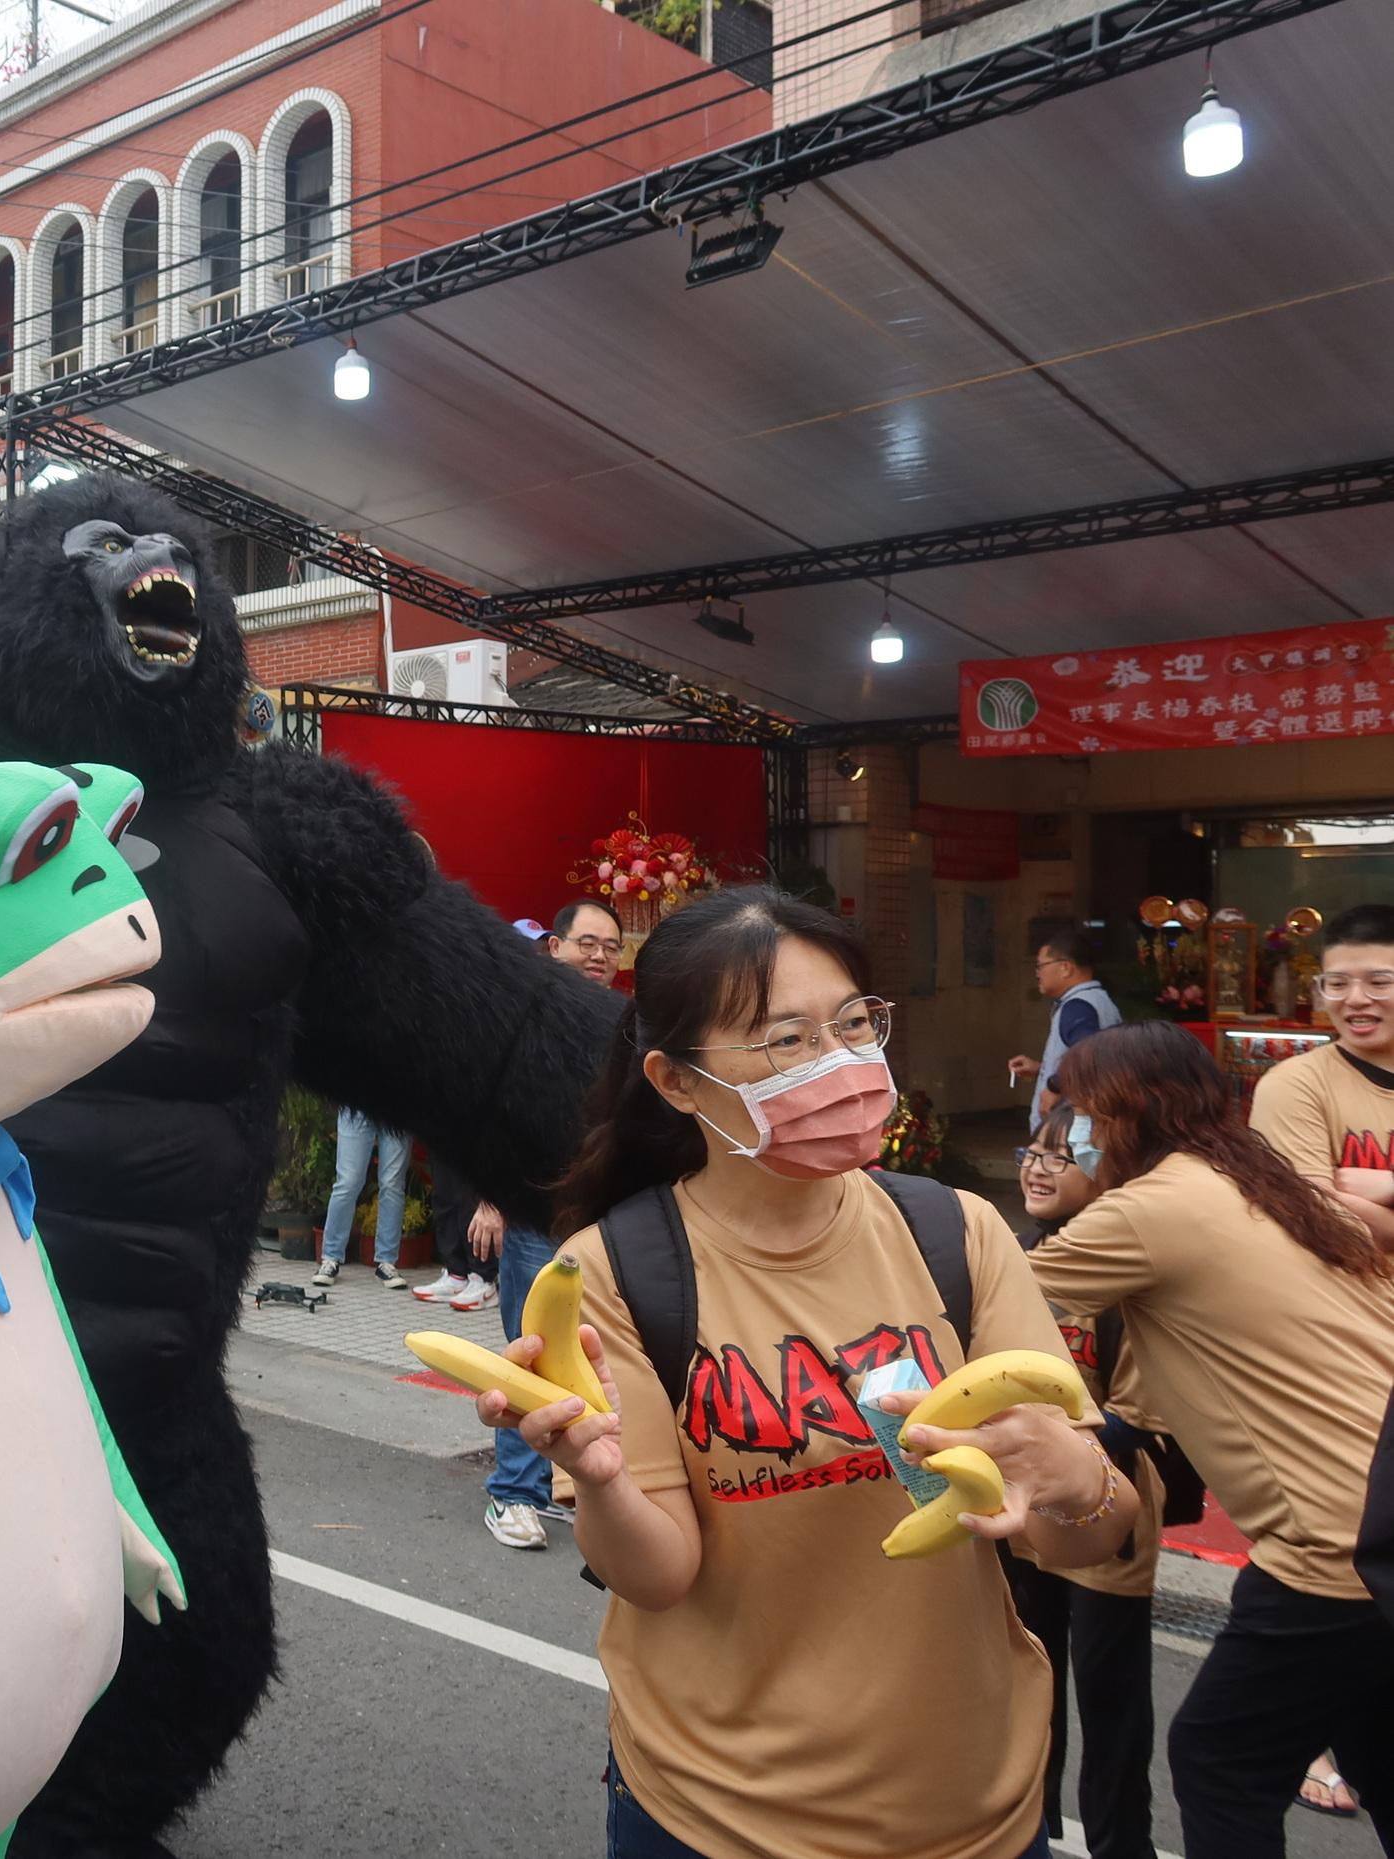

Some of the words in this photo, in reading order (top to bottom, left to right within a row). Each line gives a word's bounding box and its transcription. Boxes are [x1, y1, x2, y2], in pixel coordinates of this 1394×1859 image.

[1106, 654, 1210, 688] 恭迎
[1279, 681, 1394, 709] 常務監
[1213, 707, 1394, 741] 暨全體選聘
[707, 1464, 834, 1497] Selfless
